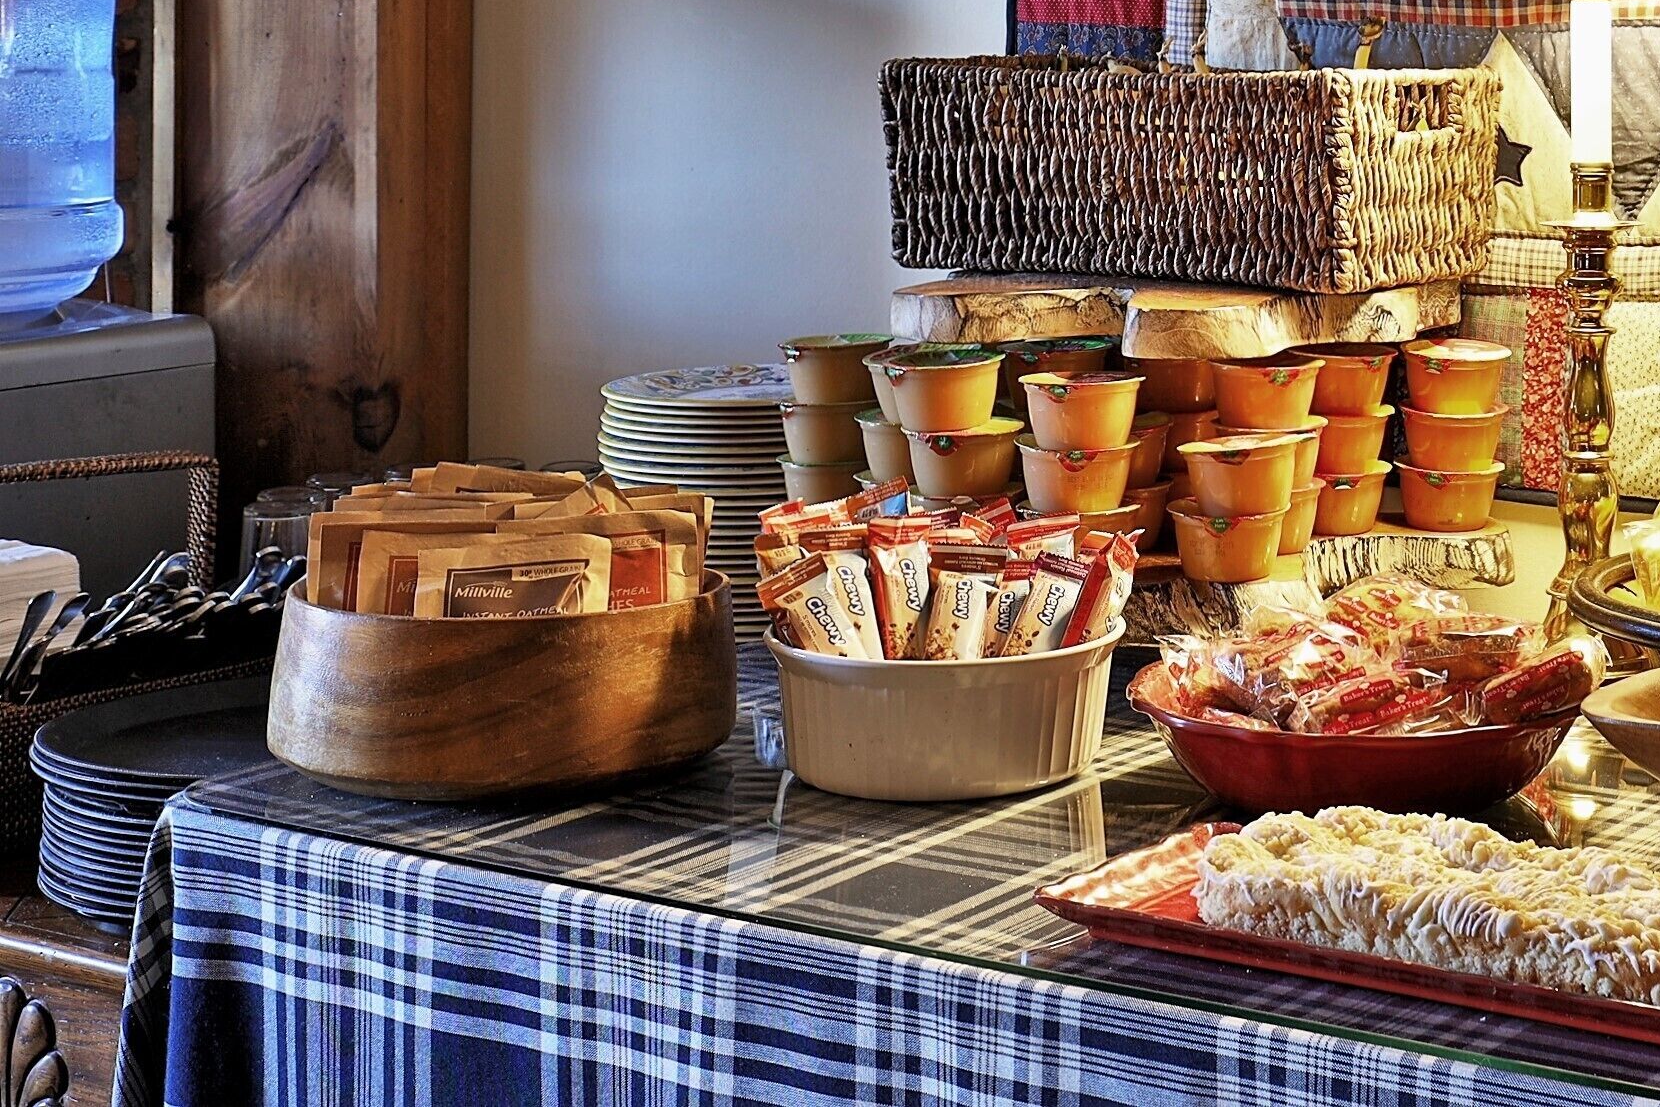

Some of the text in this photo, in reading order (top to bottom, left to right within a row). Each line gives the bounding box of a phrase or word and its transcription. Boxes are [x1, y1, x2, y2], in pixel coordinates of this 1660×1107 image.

[454, 587, 513, 599] Millville
[610, 586, 651, 597] ATMEAL
[1343, 687, 1370, 702] Baker's
[1370, 683, 1392, 695] Treat
[1380, 697, 1427, 718] Baker's Treat
[1350, 717, 1371, 729] Treat
